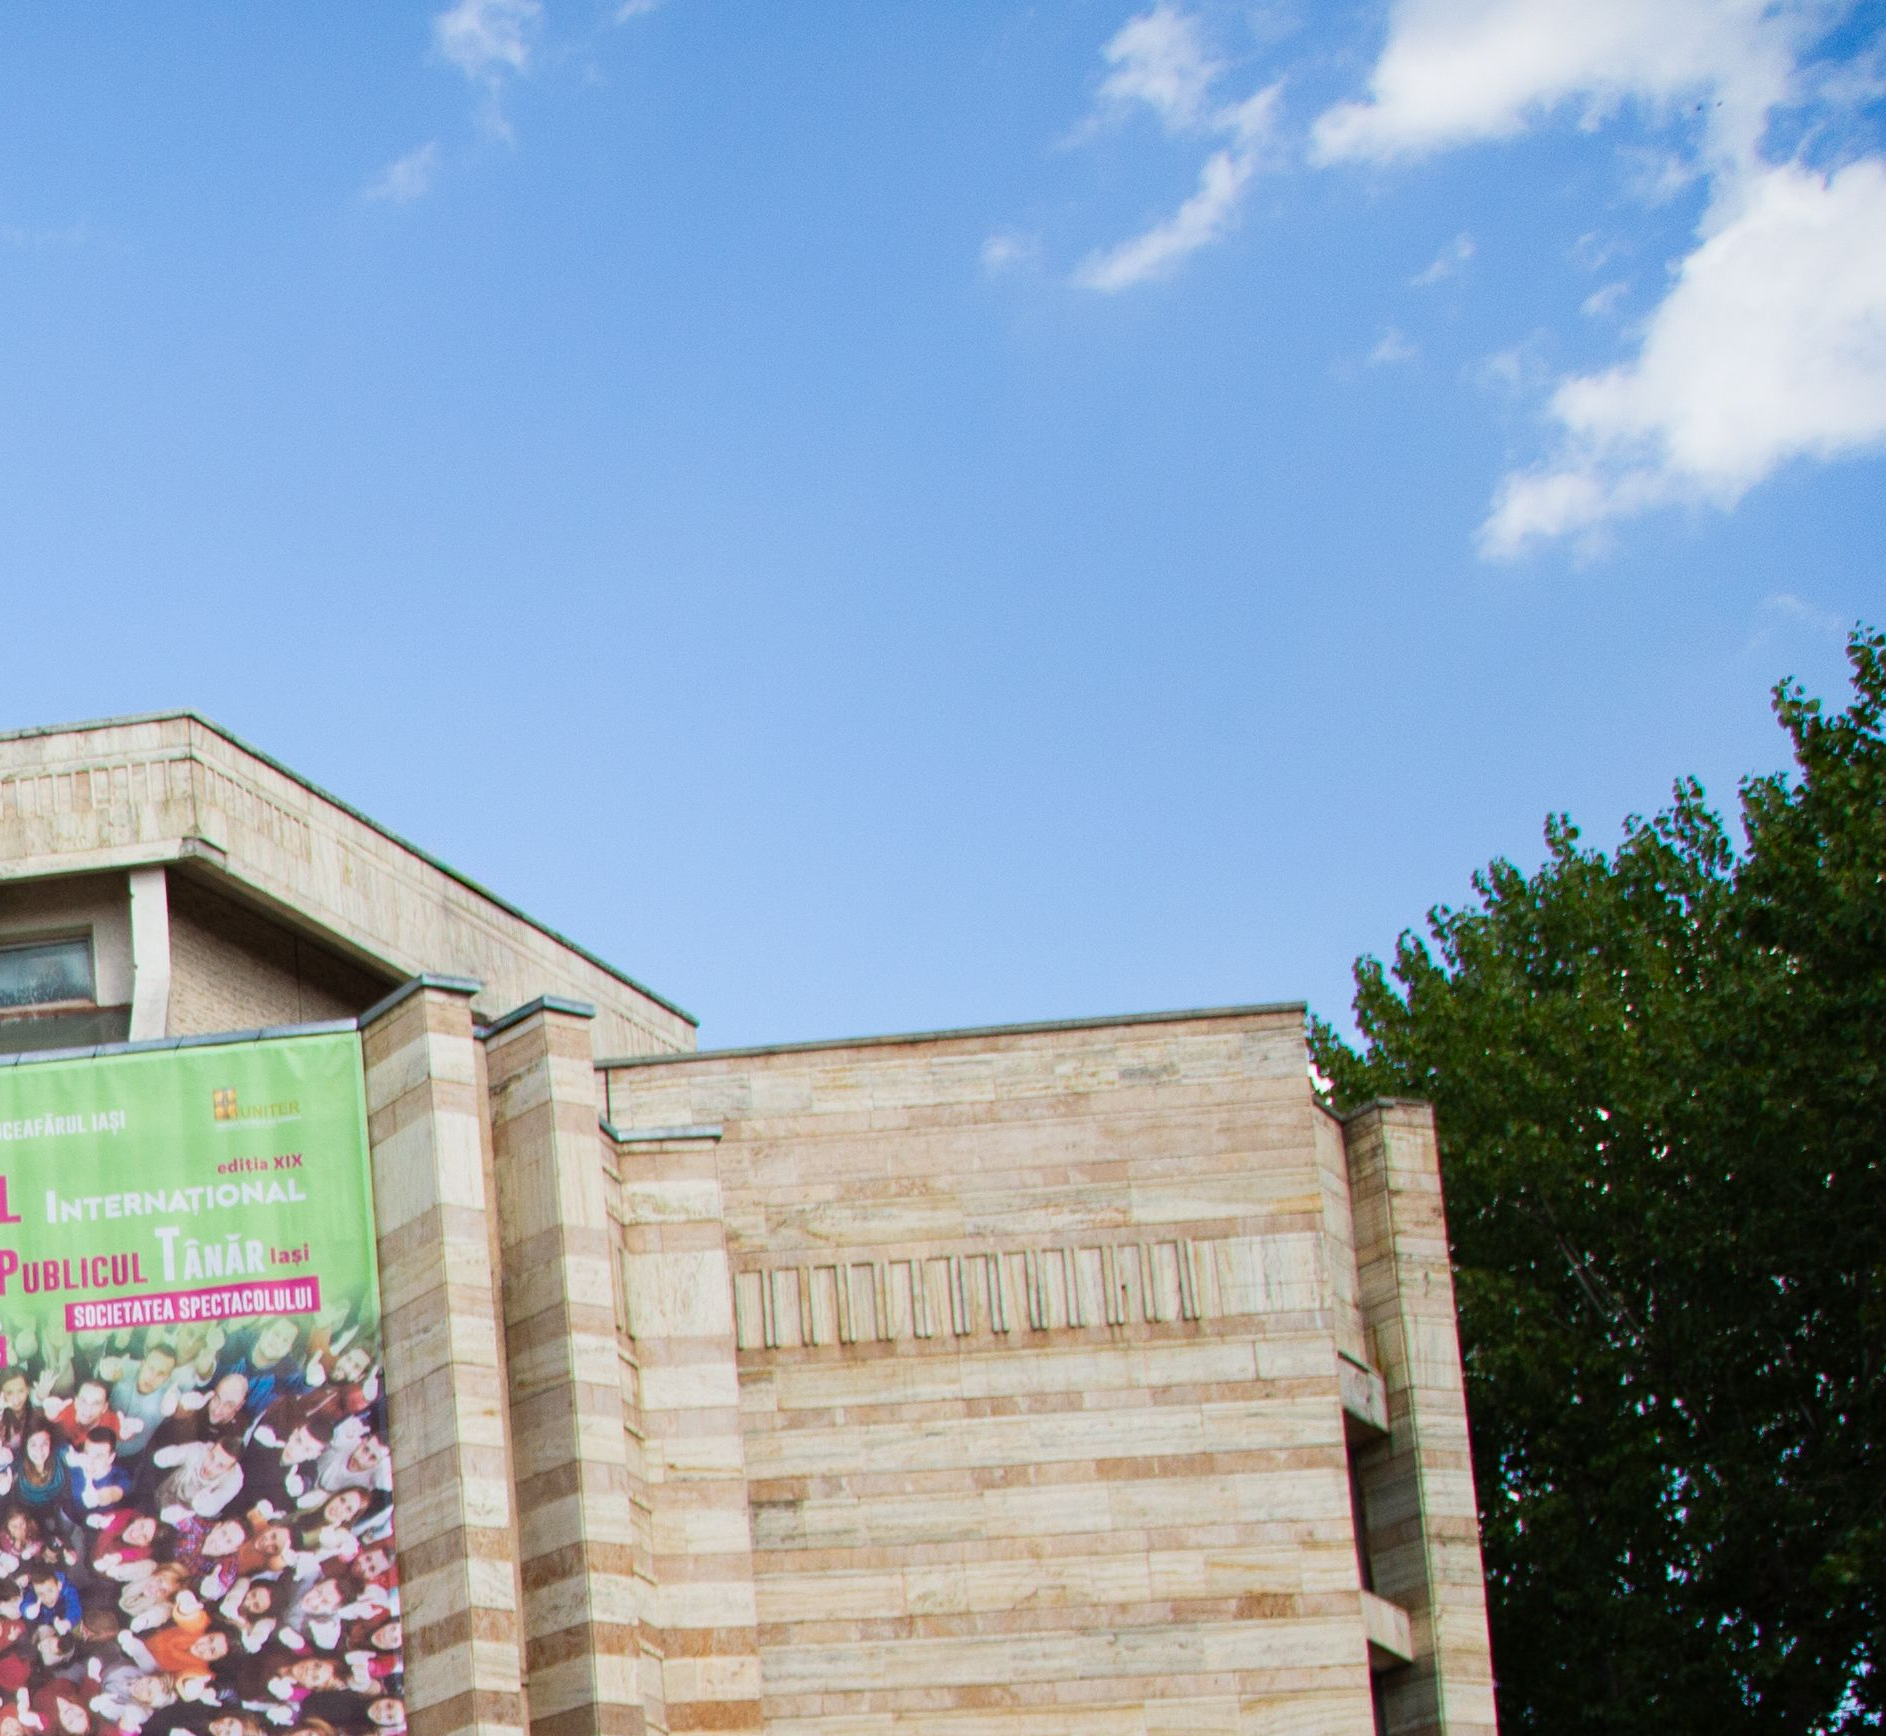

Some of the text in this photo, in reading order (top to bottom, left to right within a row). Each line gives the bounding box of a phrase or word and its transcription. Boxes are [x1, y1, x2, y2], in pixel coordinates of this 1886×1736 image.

[91, 1110, 126, 1136] IAȘI
[239, 1100, 301, 1119] UNITER
[217, 1154, 303, 1175] ediția XIX
[45, 1179, 306, 1224] INTERNAȚIONAL
[154, 1226, 266, 1282] TÂNĂR
[270, 1243, 310, 1266] Iași
[74, 1287, 313, 1328] SOCIETATEA SPECTACOLULUI
